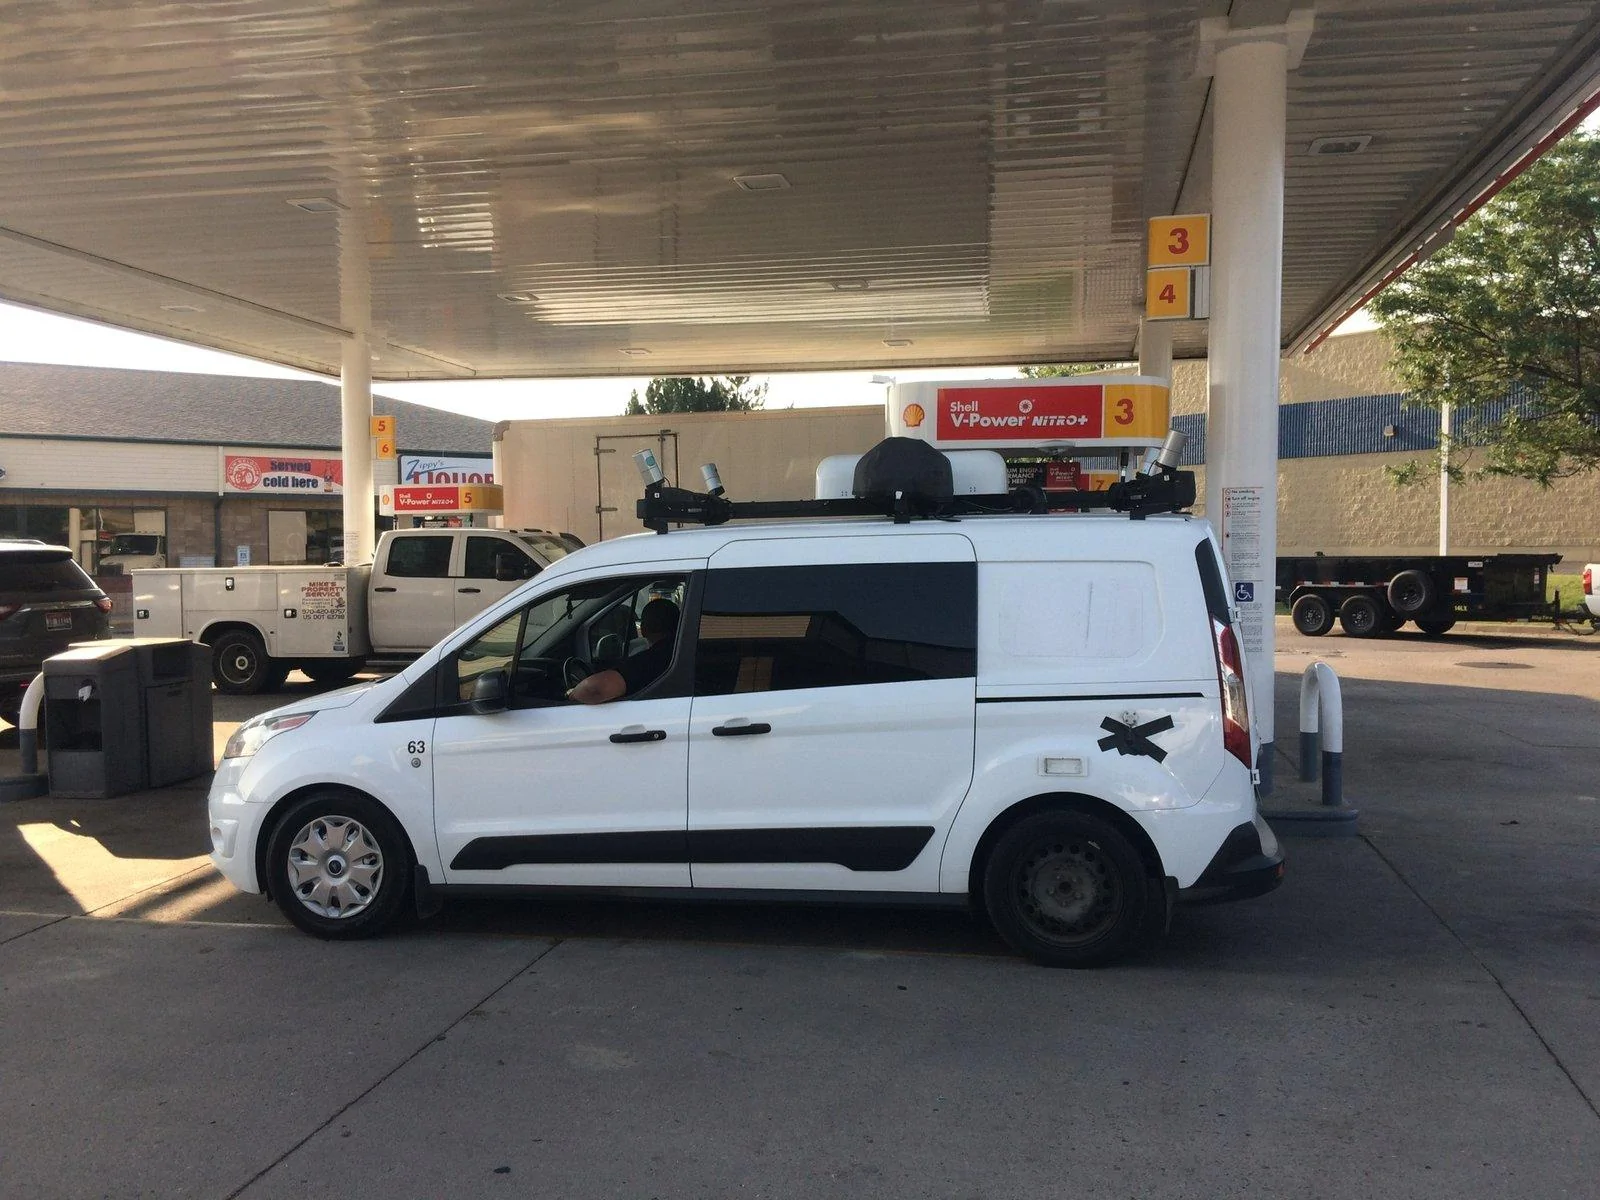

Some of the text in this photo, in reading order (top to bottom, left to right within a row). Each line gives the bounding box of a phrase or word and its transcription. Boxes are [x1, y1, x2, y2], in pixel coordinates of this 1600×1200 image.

[1168, 228, 1190, 254] 3
[1159, 284, 1176, 303] 4
[950, 401, 978, 412] Shell
[1114, 399, 1134, 426] 3
[378, 421, 386, 431] 5
[951, 413, 1025, 428] V-Power
[382, 444, 389, 453] 6
[270, 460, 312, 472] Served
[405, 459, 444, 481] Zippy's
[263, 475, 319, 488] cold here
[464, 492, 472, 504] 5
[408, 740, 425, 754] 63
